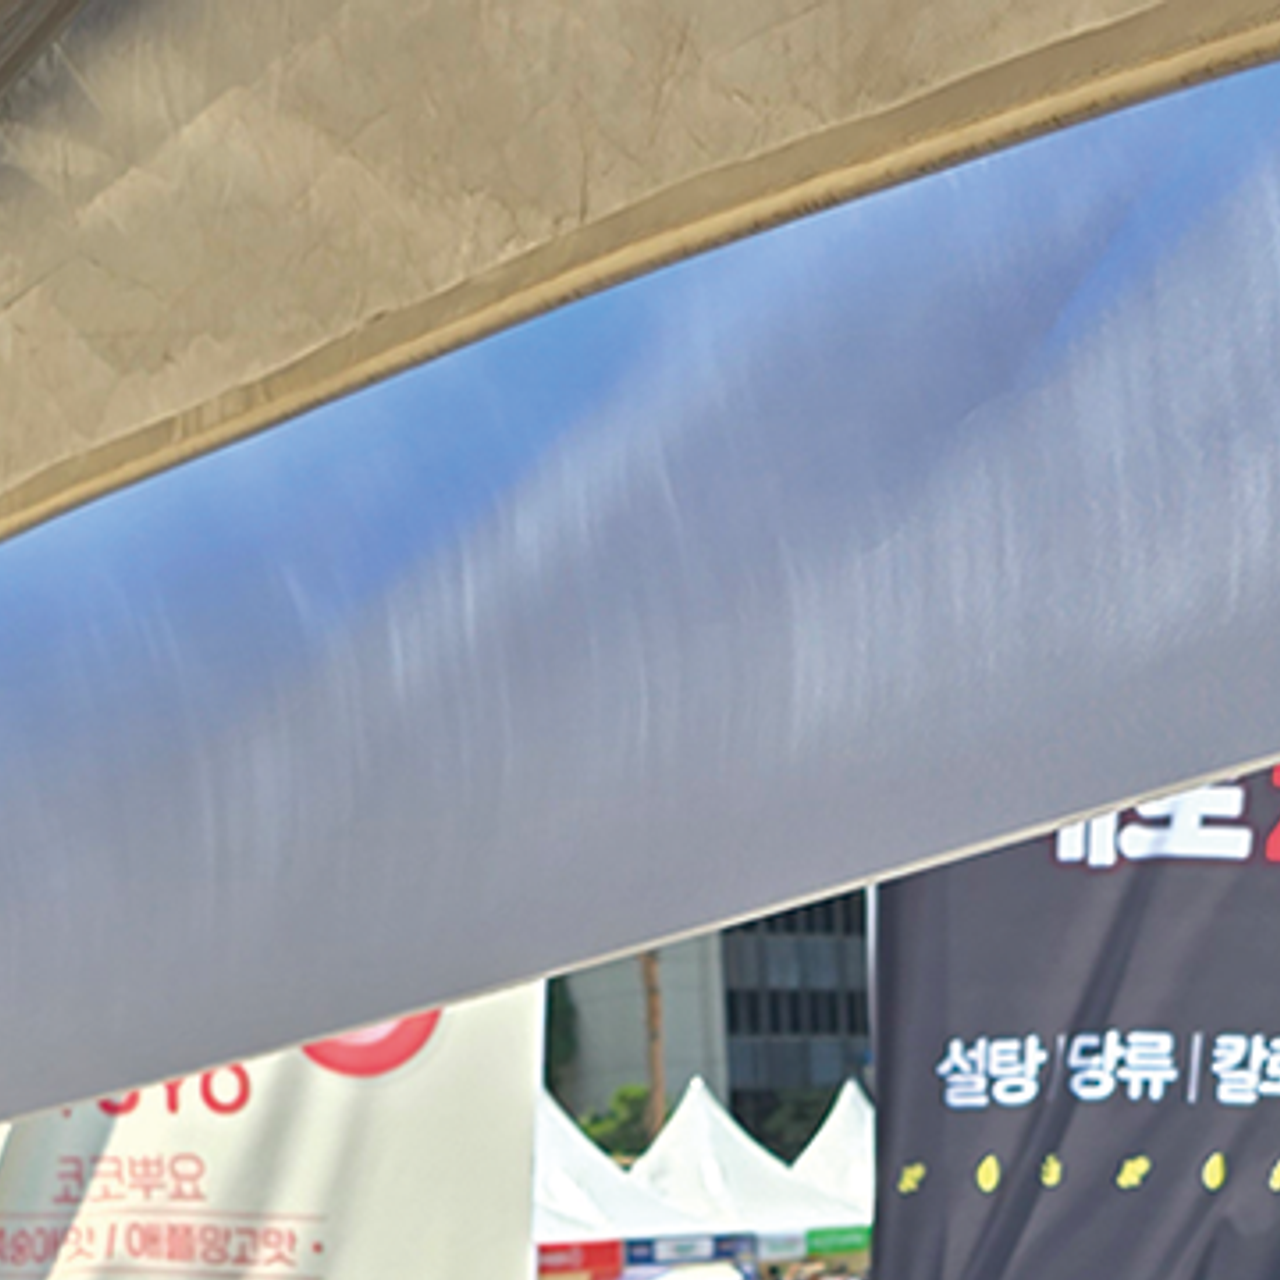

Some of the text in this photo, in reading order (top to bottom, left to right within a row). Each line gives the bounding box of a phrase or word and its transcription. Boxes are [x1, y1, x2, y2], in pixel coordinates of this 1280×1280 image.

[936, 1034, 1048, 1107] 설탕
[1067, 1029, 1179, 1102] 당류
[51, 1152, 208, 1205] 코코뿌요
[124, 1221, 297, 1267] 애플망고맛
